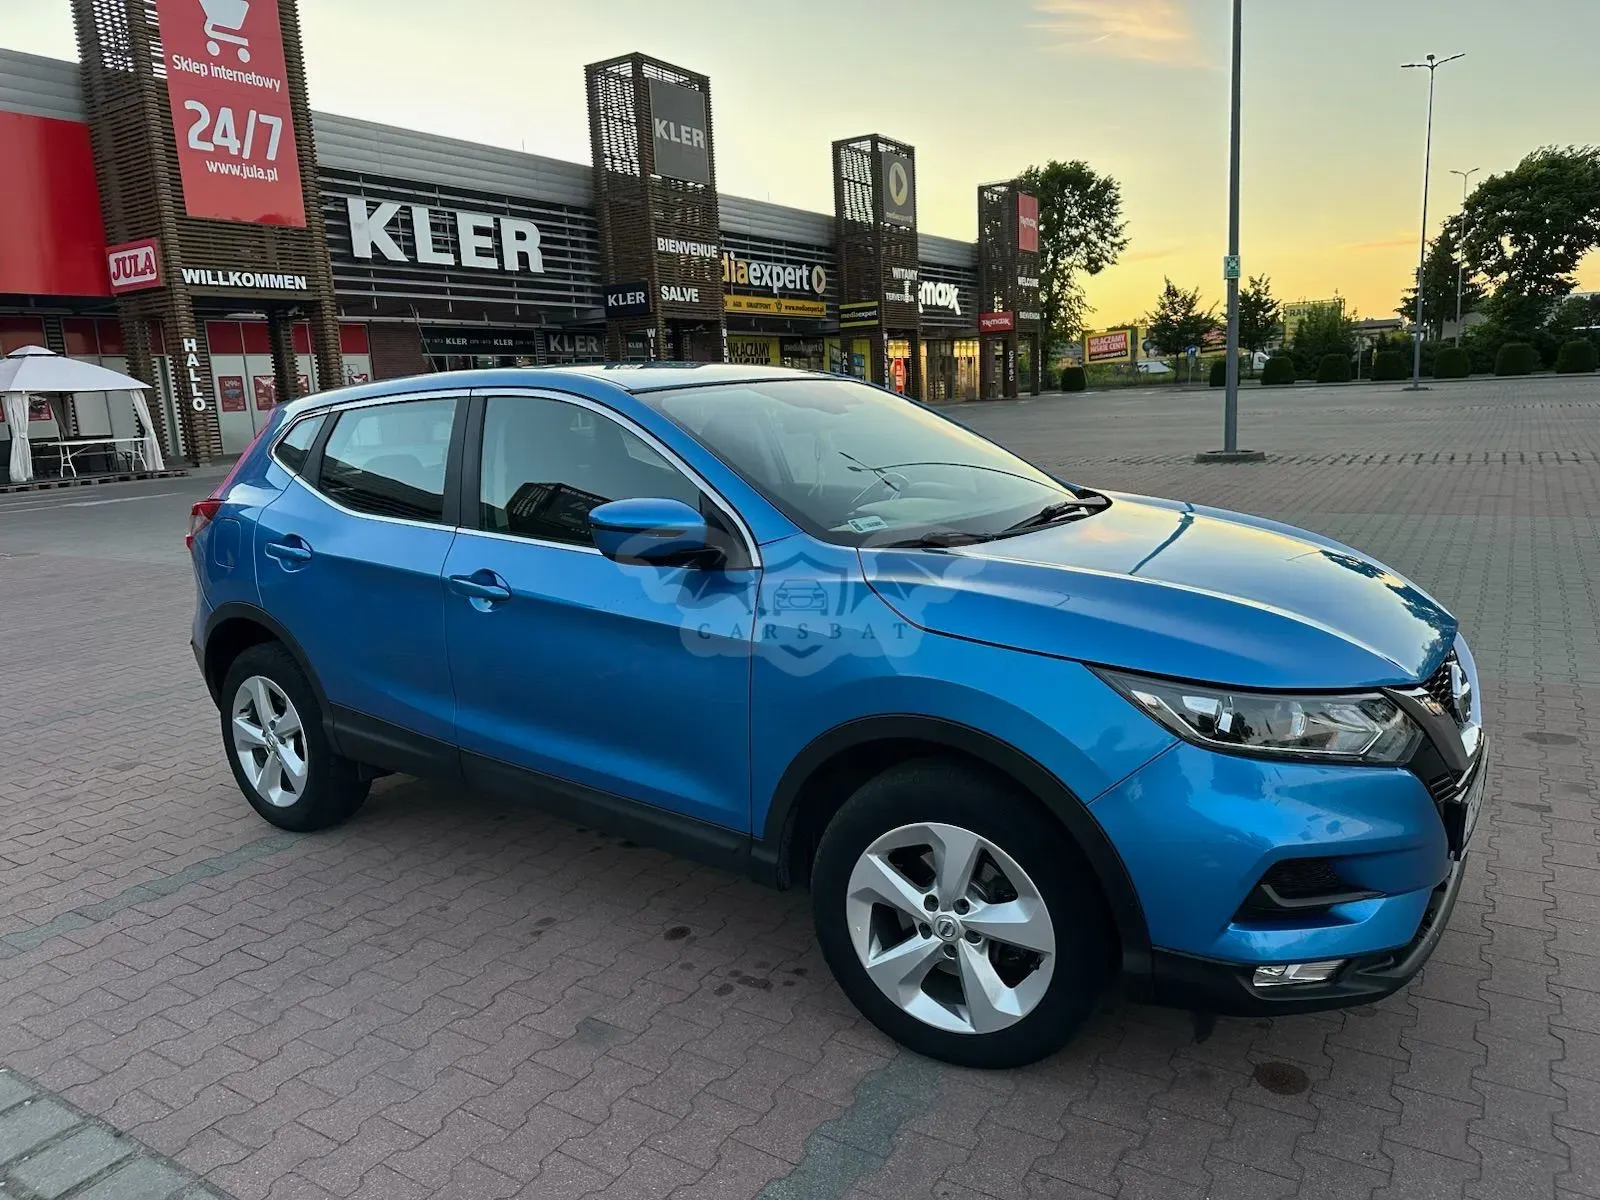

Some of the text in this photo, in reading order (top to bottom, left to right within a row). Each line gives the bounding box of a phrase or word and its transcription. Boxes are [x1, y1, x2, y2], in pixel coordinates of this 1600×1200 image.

[172, 54, 281, 93] Sklep internetowy
[184, 100, 282, 161] 24/7
[654, 118, 705, 149] KLER
[205, 160, 278, 182] www.jula.pl
[347, 197, 545, 274] KLER
[657, 237, 718, 258] BIENVENUE
[112, 252, 155, 280] JULA
[181, 267, 307, 290] WILLKOMMEN
[607, 291, 646, 307] KLER
[660, 285, 700, 303] SALVE
[446, 337, 468, 345] KLER
[549, 334, 599, 353] KLER
[646, 328, 657, 362] WIL
[182, 338, 207, 412] HALLO
